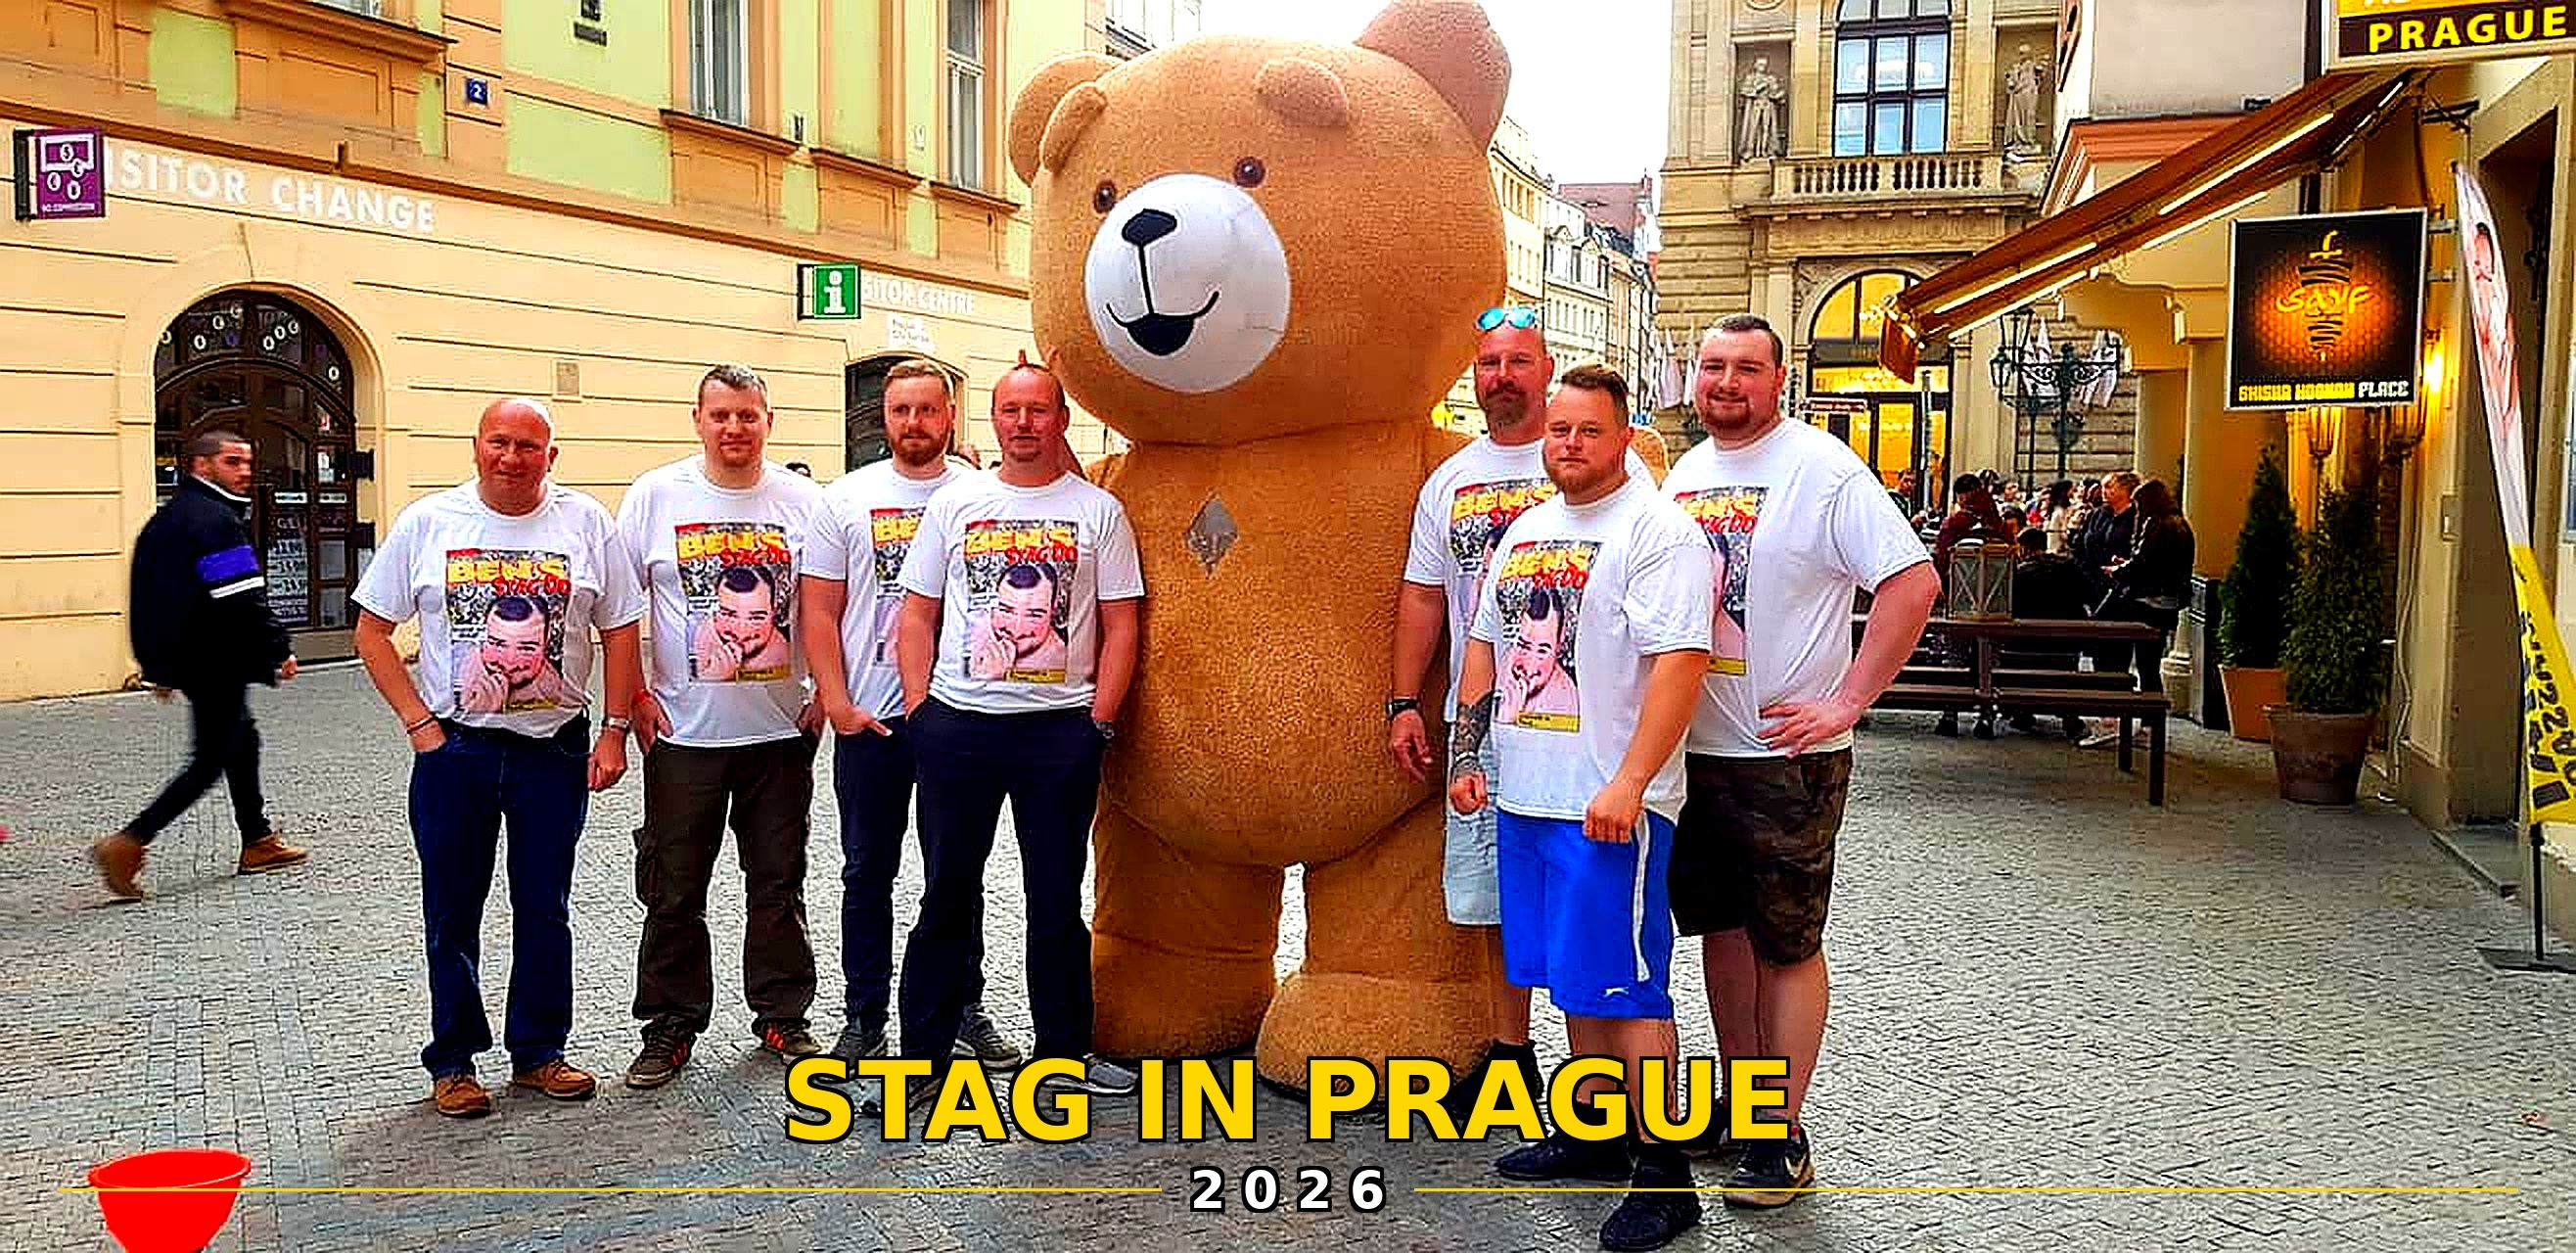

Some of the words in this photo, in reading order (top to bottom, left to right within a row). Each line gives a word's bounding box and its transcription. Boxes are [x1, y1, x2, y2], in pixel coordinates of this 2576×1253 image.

[2369, 6, 2567, 53] PRAGUE
[105, 144, 248, 204] ISITOR
[271, 174, 435, 233] CHANGE
[2358, 381, 2410, 399] PLACE
